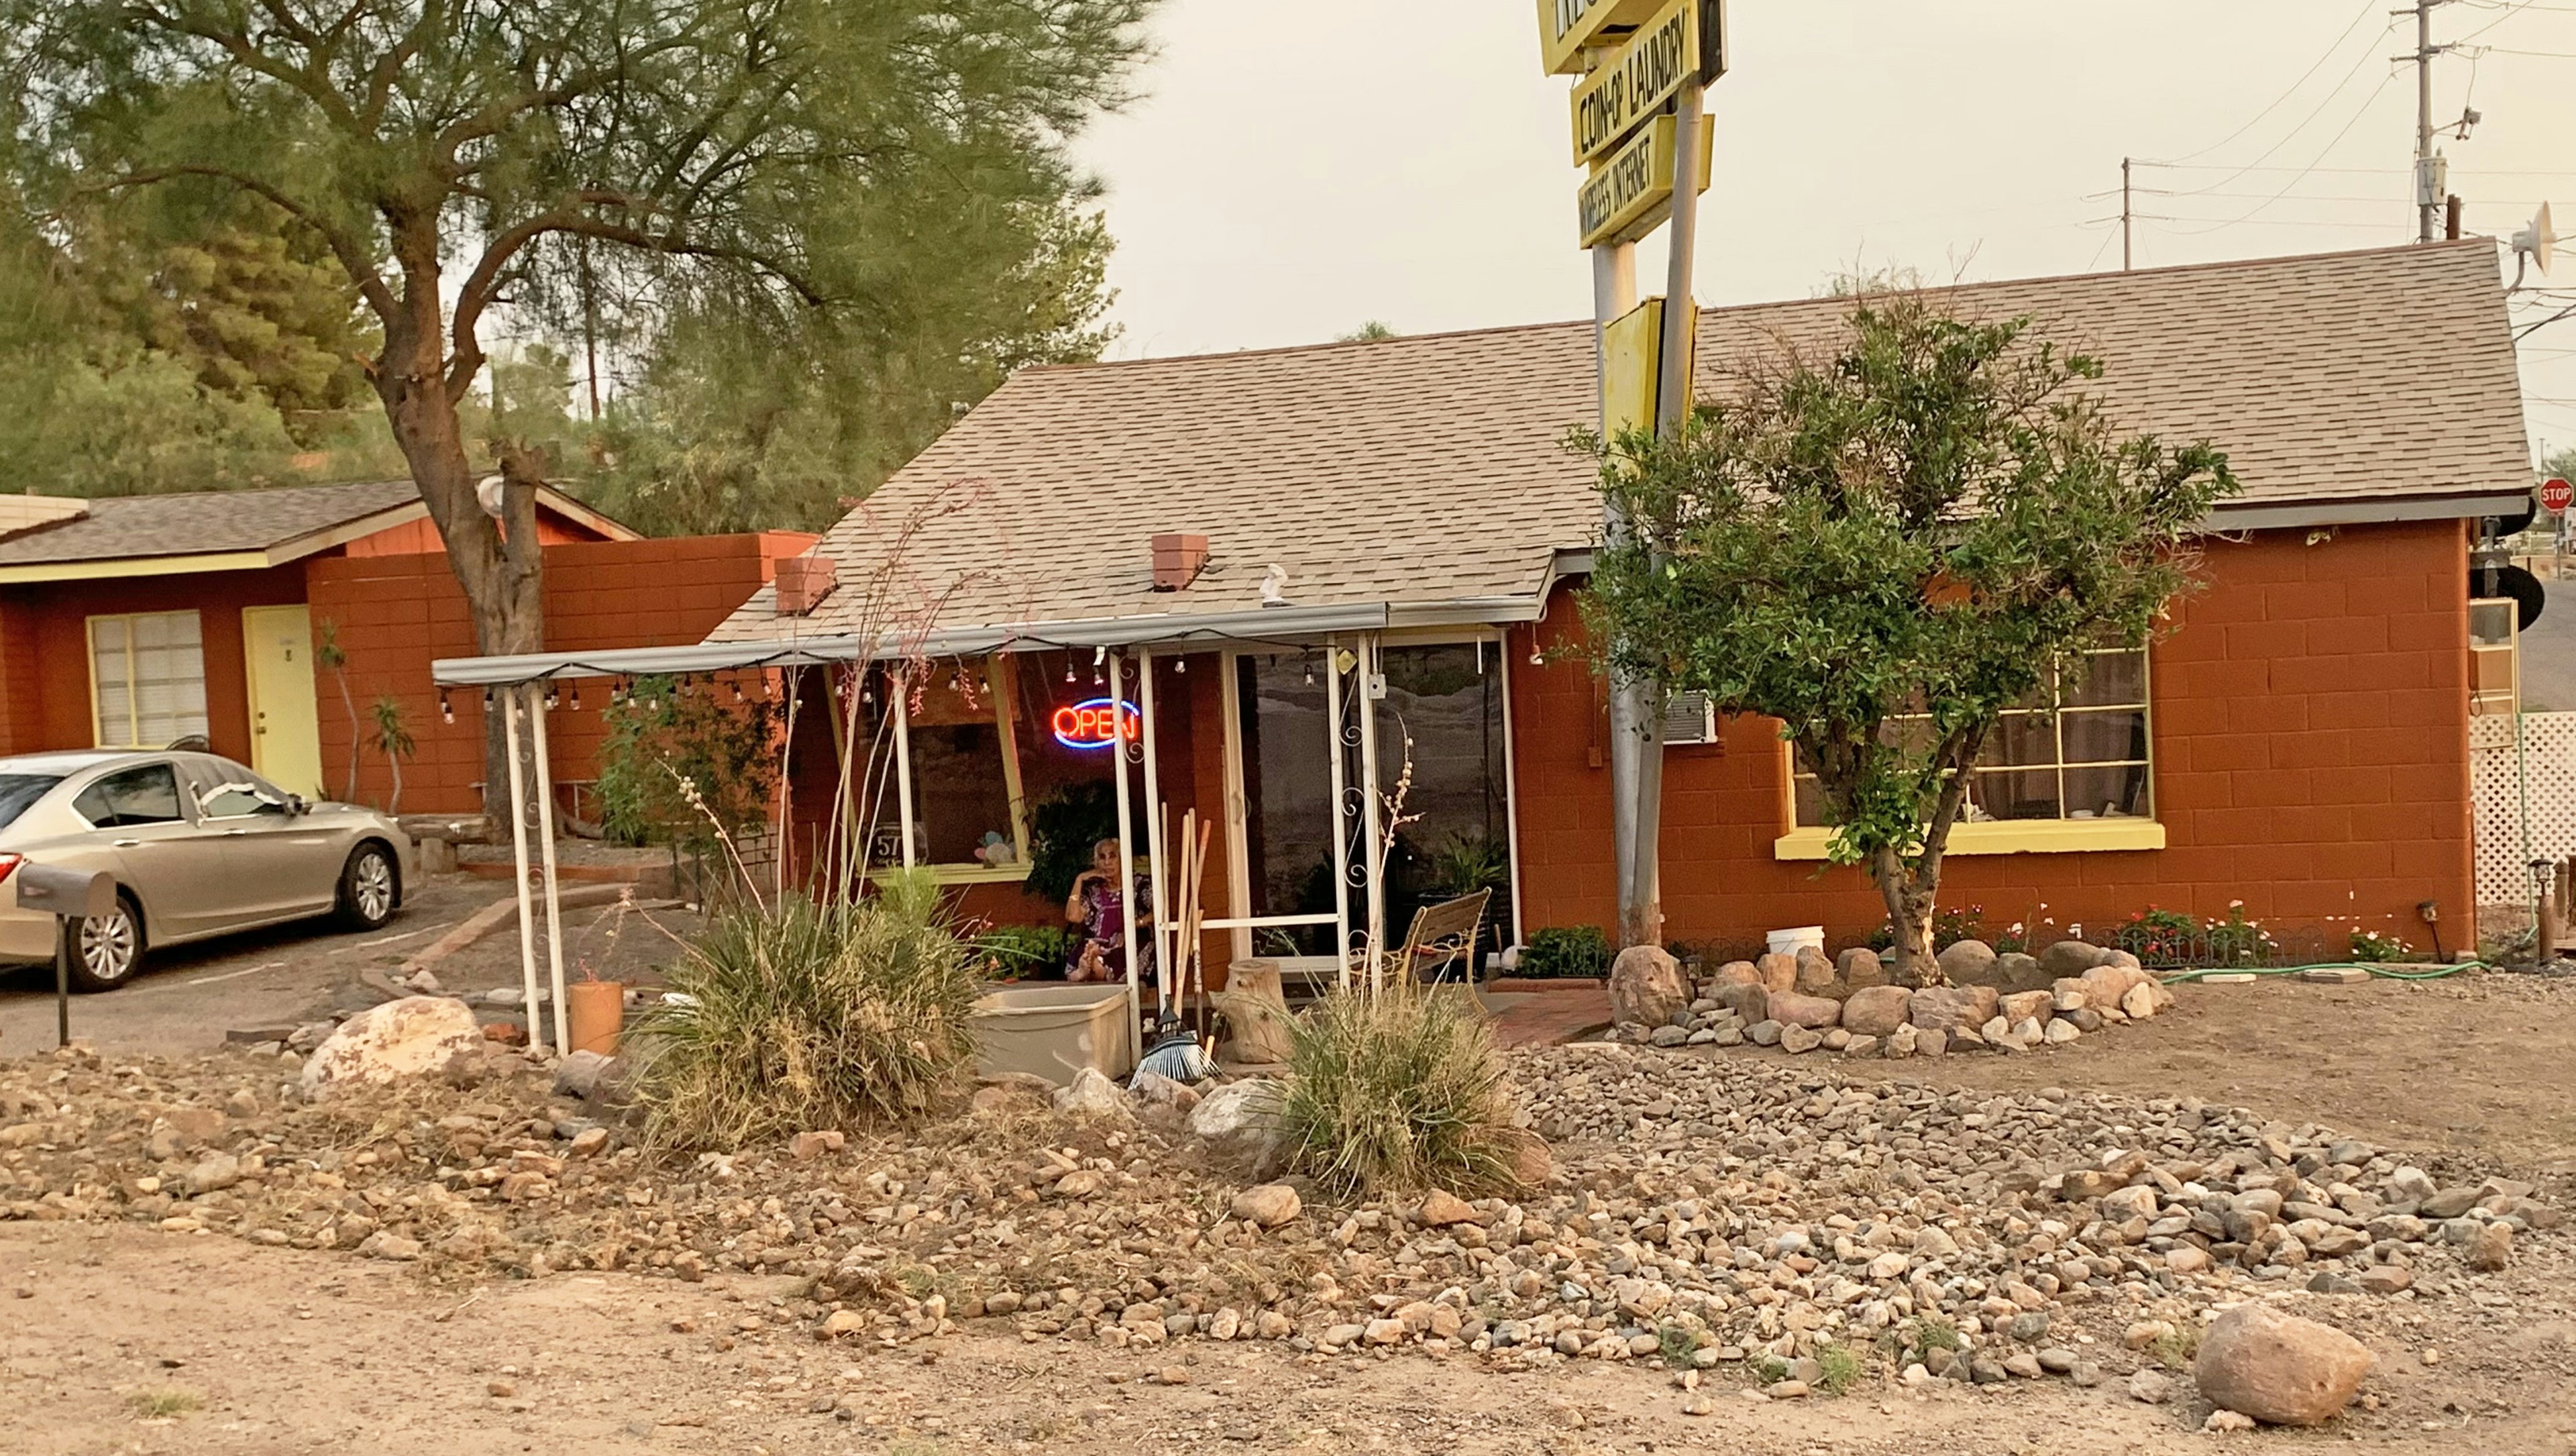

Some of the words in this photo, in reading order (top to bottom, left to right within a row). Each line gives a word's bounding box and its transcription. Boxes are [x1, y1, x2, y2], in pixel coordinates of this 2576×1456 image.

[1580, 70, 1623, 154] COIN-OP
[1629, 7, 1685, 117] LAUNDRY
[1580, 170, 1610, 238] WIRELESS
[1613, 134, 1650, 213] INTERNET
[2542, 487, 2571, 502] STOP
[1054, 707, 1136, 739] OPEN
